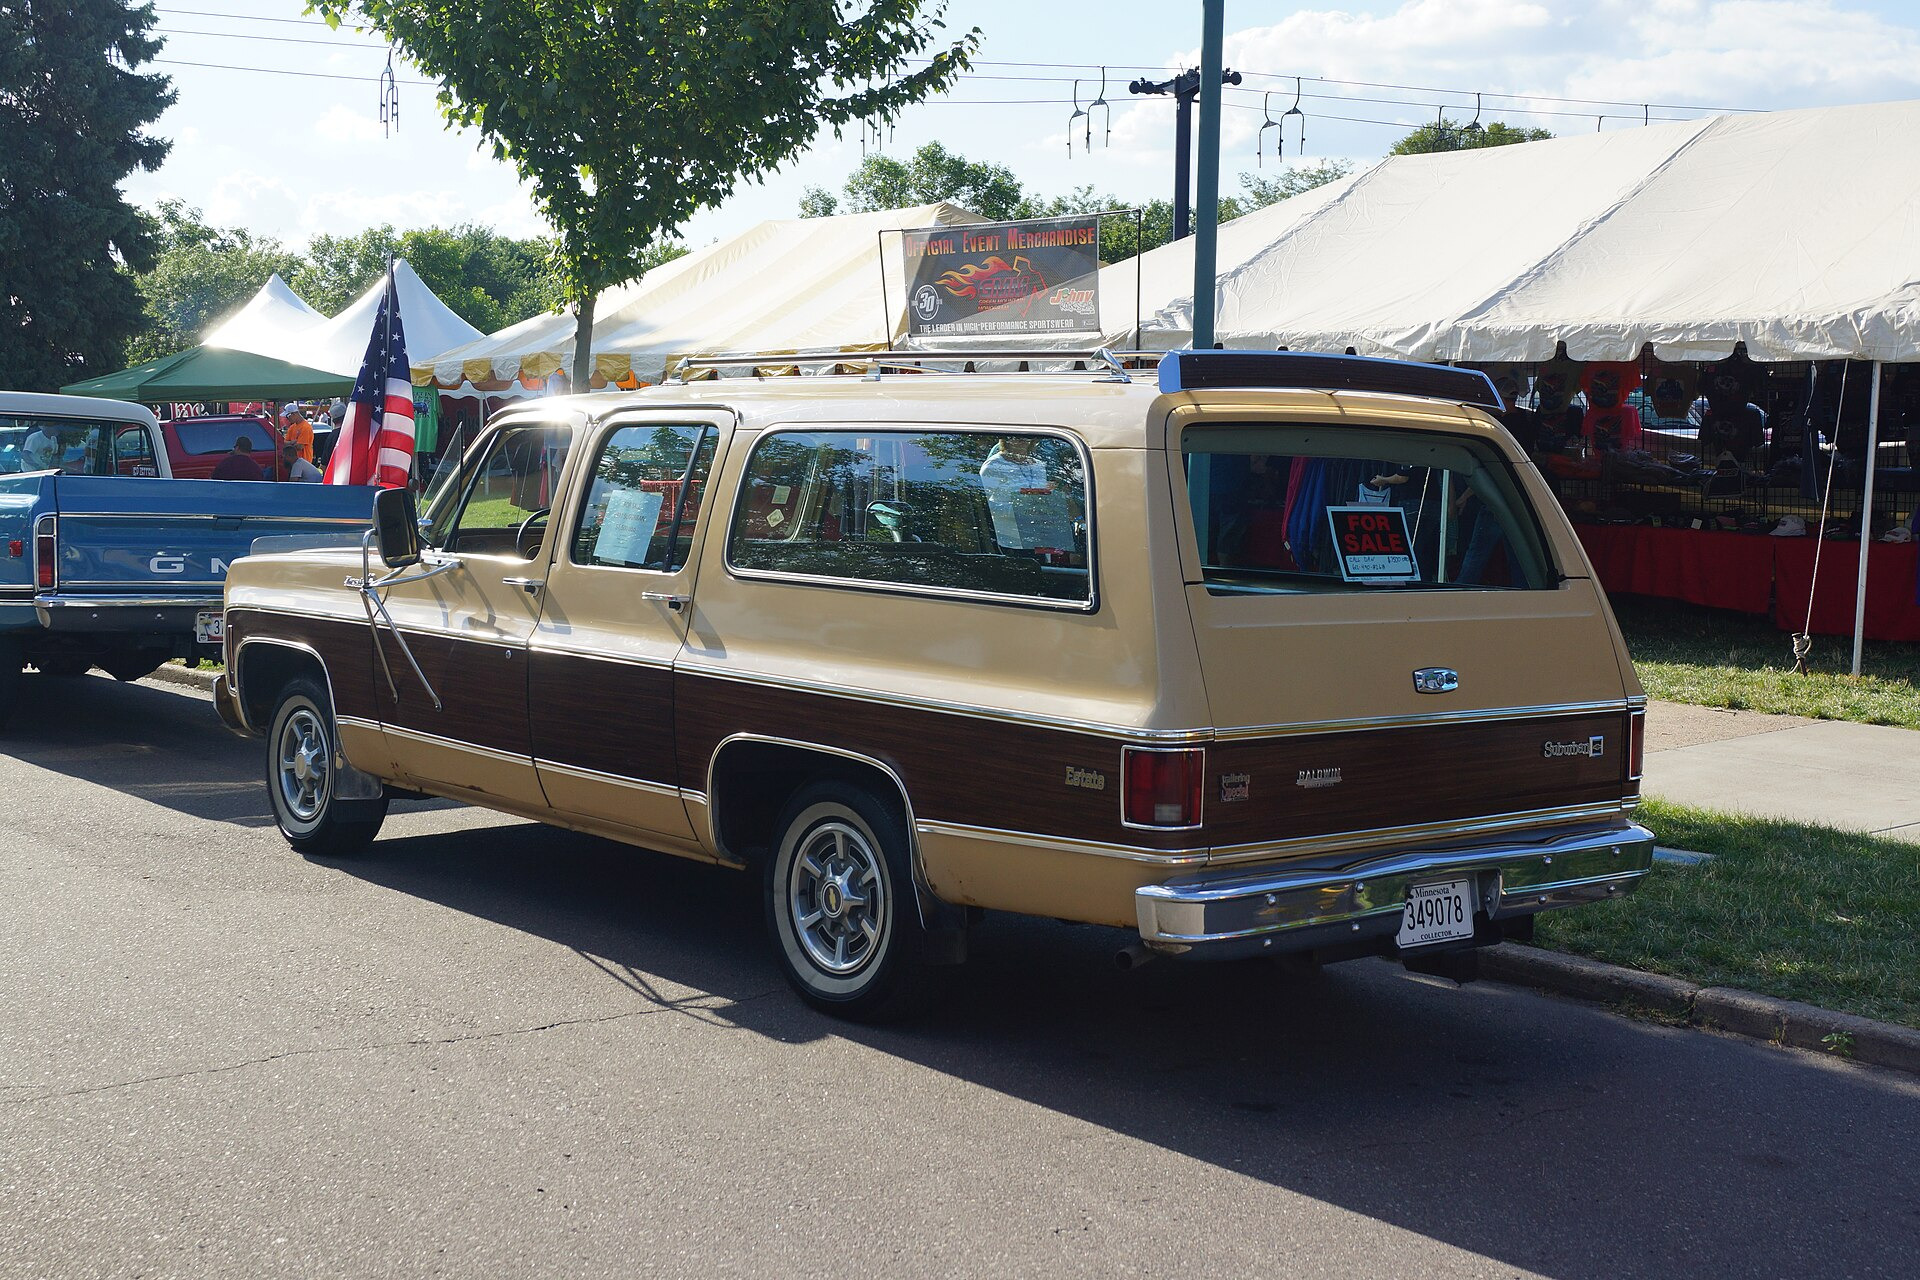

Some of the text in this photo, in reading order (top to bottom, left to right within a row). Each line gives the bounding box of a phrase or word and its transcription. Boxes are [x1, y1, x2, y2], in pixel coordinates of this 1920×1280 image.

[906, 227, 1096, 257] OFFICIAL EVENT MERCHANDISE
[919, 293, 936, 312] 30
[919, 324, 932, 333] THE
[932, 323, 956, 333] LEADER
[964, 320, 1028, 332] HIGH-PERFORMANCE
[1029, 319, 1074, 330] SPORTSWEAR
[1347, 514, 1391, 531] FOR
[1344, 533, 1404, 552] SALE
[1065, 766, 1105, 790] Estate
[1298, 767, 1342, 781] BALDWIN
[1415, 887, 1450, 899] Minnesota
[1405, 895, 1464, 931] 349078
[1420, 930, 1453, 941] COLLECTOR
